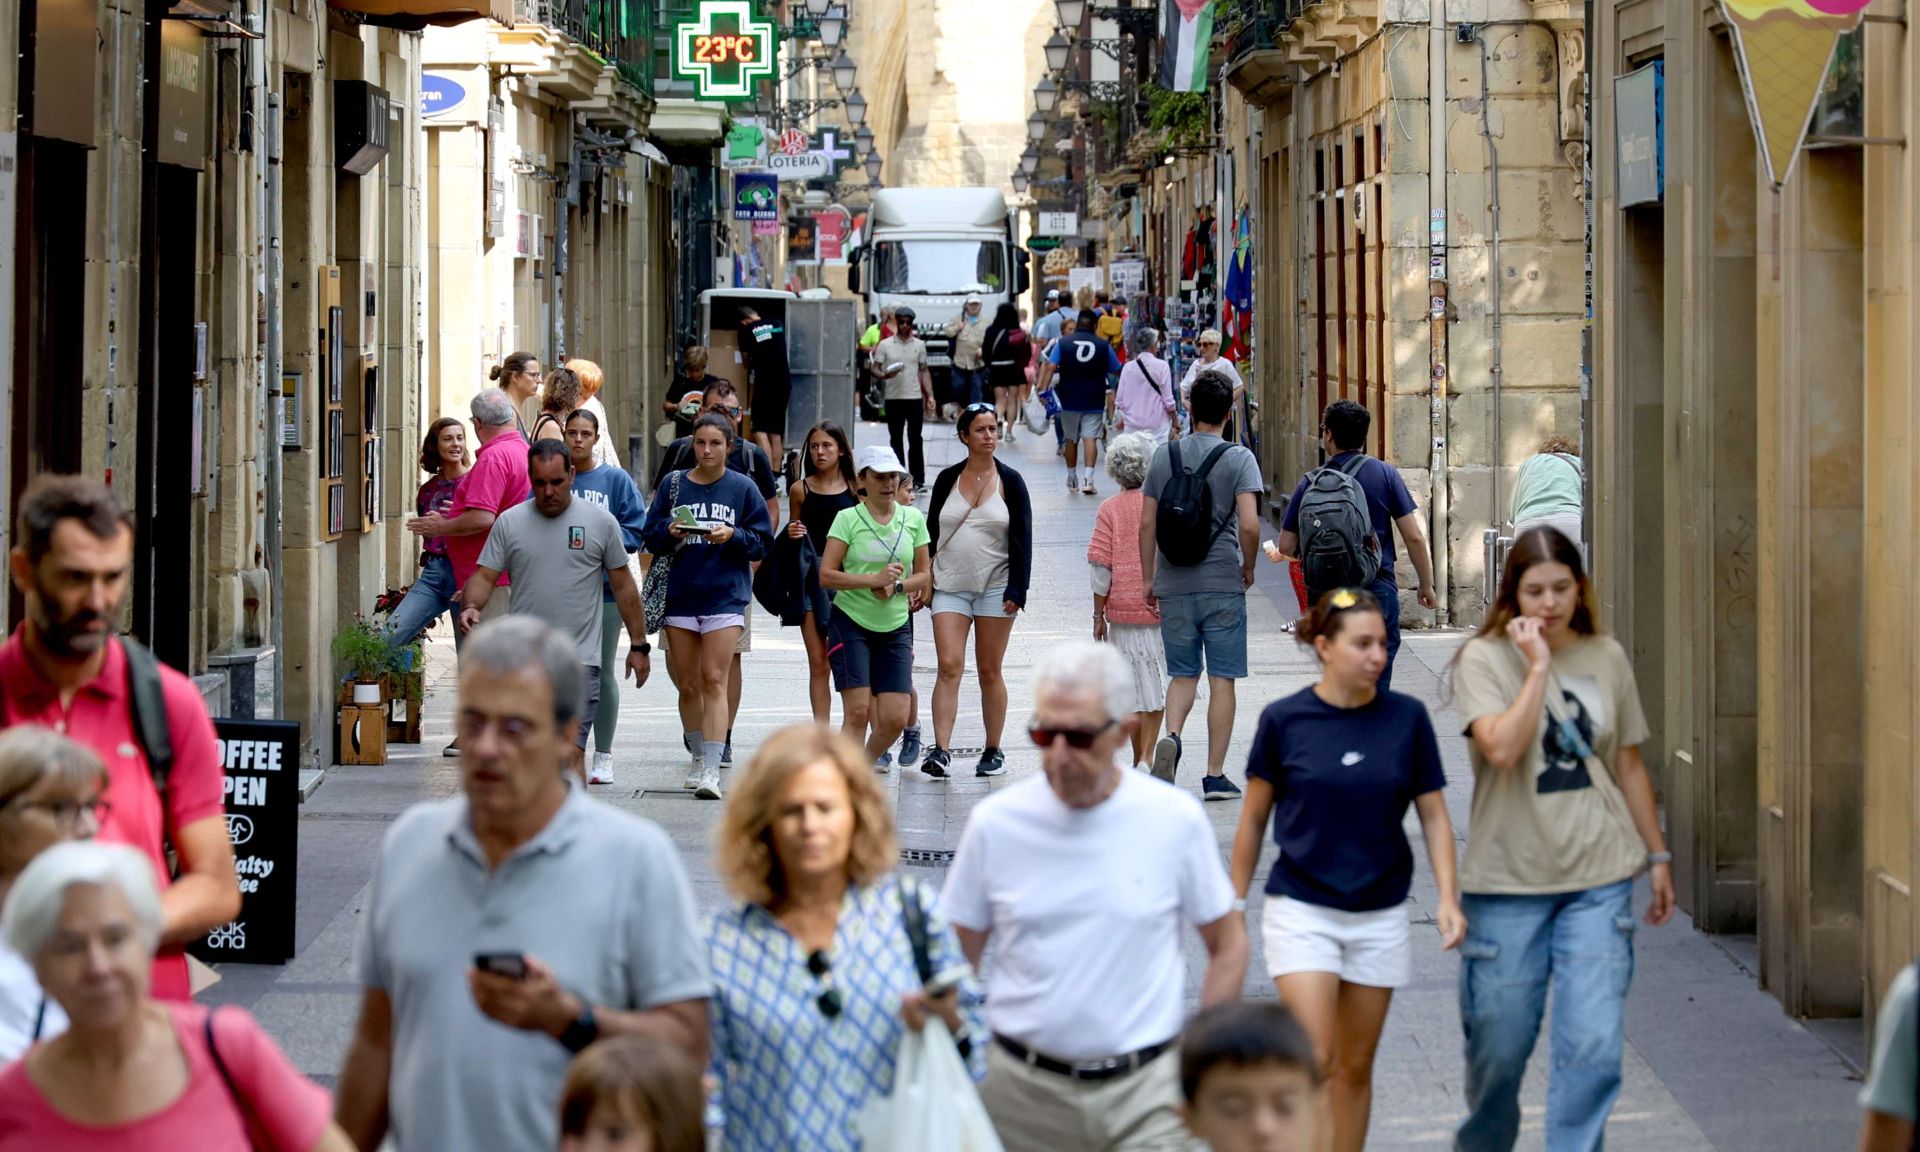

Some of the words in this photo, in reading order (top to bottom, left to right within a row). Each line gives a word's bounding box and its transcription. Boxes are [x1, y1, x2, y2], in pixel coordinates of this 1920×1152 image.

[768, 155, 820, 168] LOTERIA
[689, 503, 708, 519] TA
[711, 503, 736, 526] RICA
[216, 738, 283, 771] OFFEE
[219, 775, 268, 807] PEN
